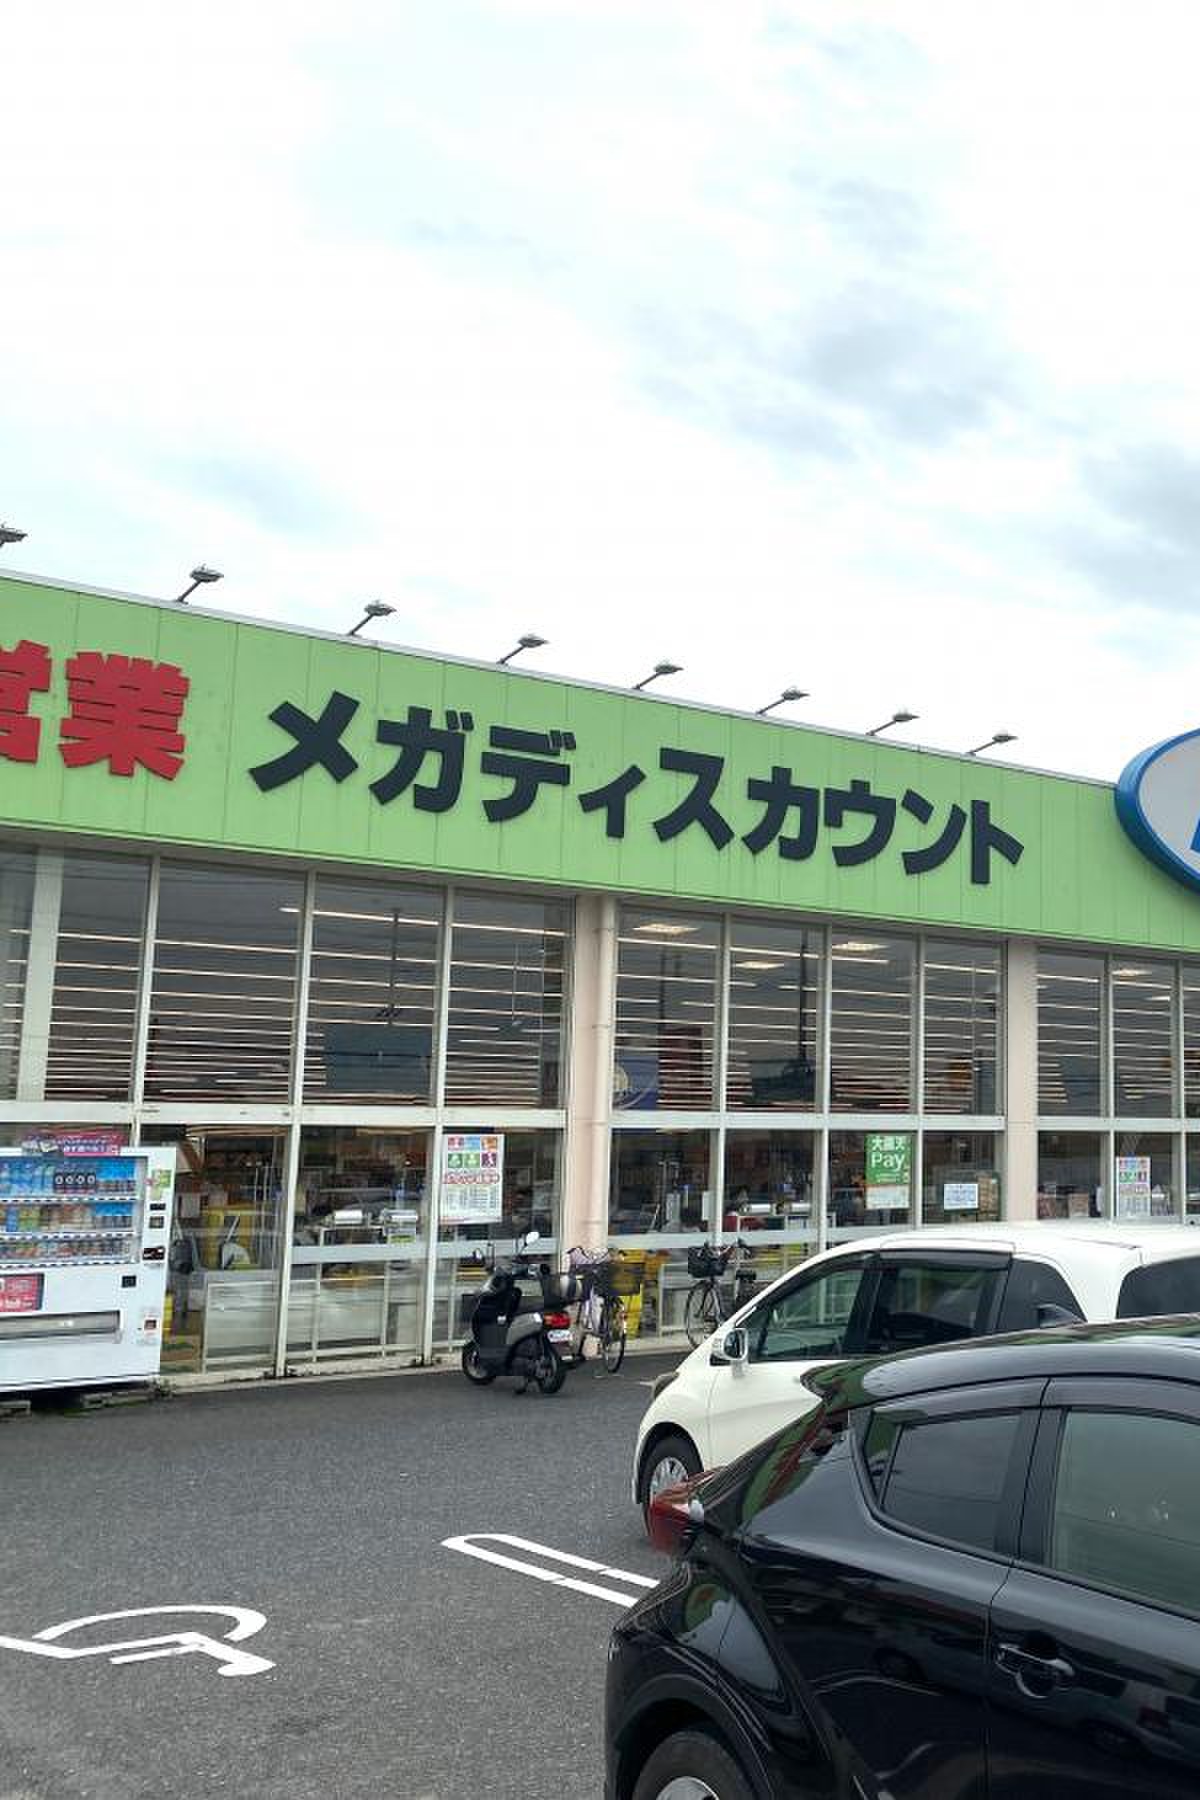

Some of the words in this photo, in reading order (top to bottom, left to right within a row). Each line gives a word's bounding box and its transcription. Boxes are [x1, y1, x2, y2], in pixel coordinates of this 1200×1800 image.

[248, 690, 1025, 885] メガディスカウント
[871, 1152, 905, 1172] Pay
